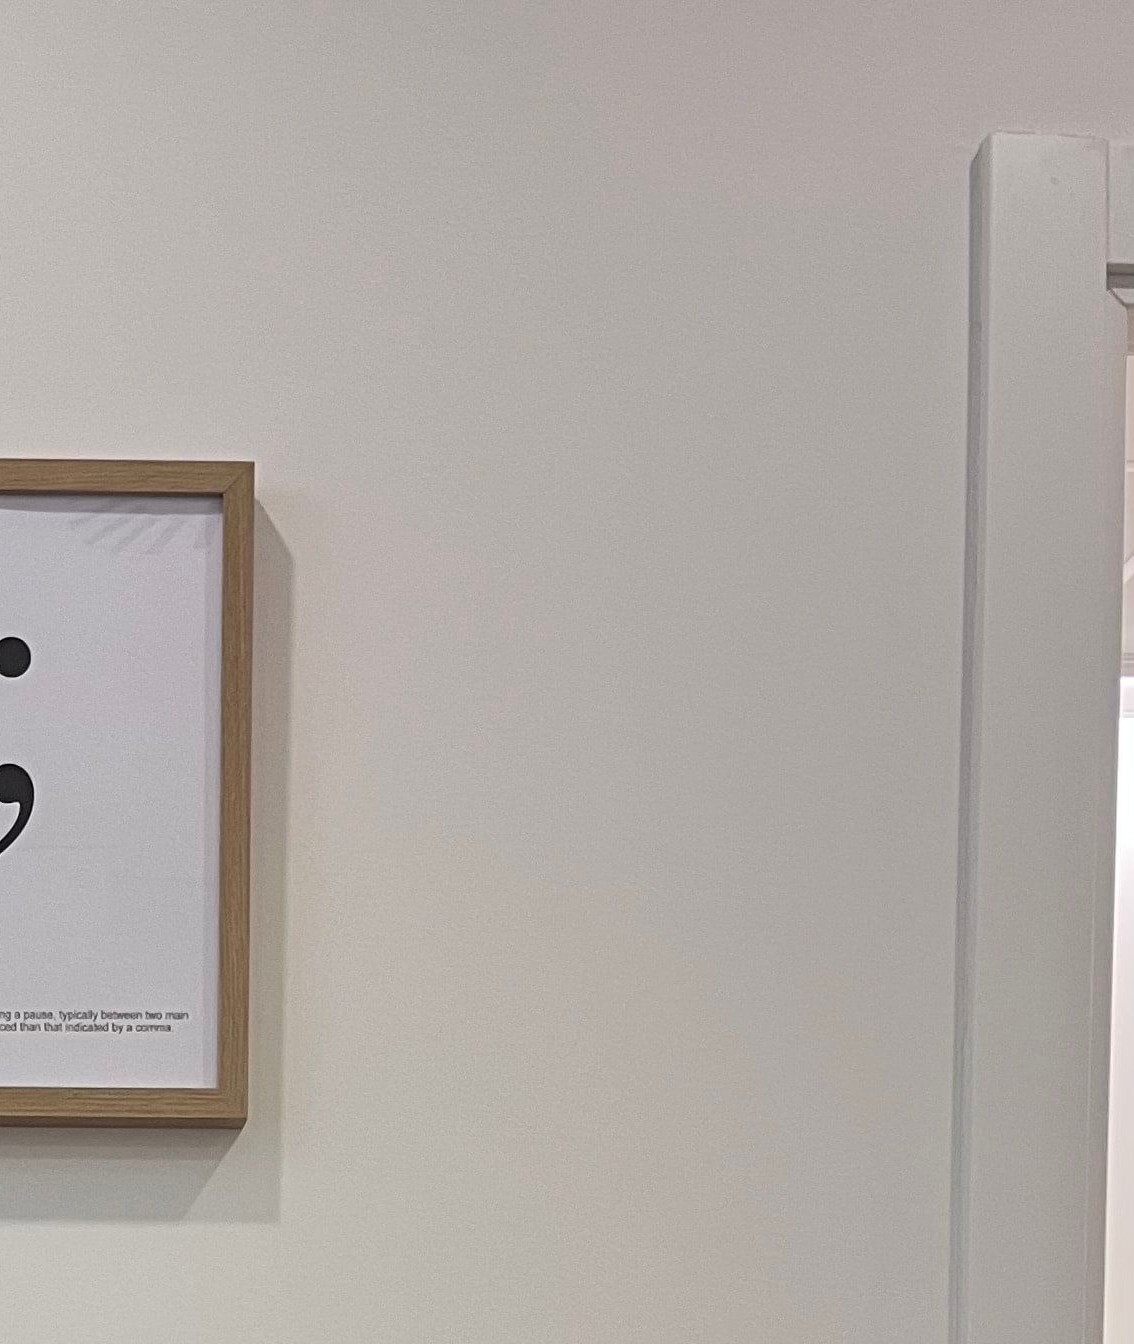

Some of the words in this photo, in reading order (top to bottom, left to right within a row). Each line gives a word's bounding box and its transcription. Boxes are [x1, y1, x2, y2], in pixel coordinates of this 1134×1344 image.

[59, 1010, 99, 1022] typically
[100, 1010, 143, 1020] between
[144, 1010, 163, 1020] two
[164, 1010, 190, 1020] main
[18, 1021, 41, 1032] than
[43, 1022, 63, 1032] that
[64, 1022, 110, 1033] indicated
[111, 1022, 125, 1034] by
